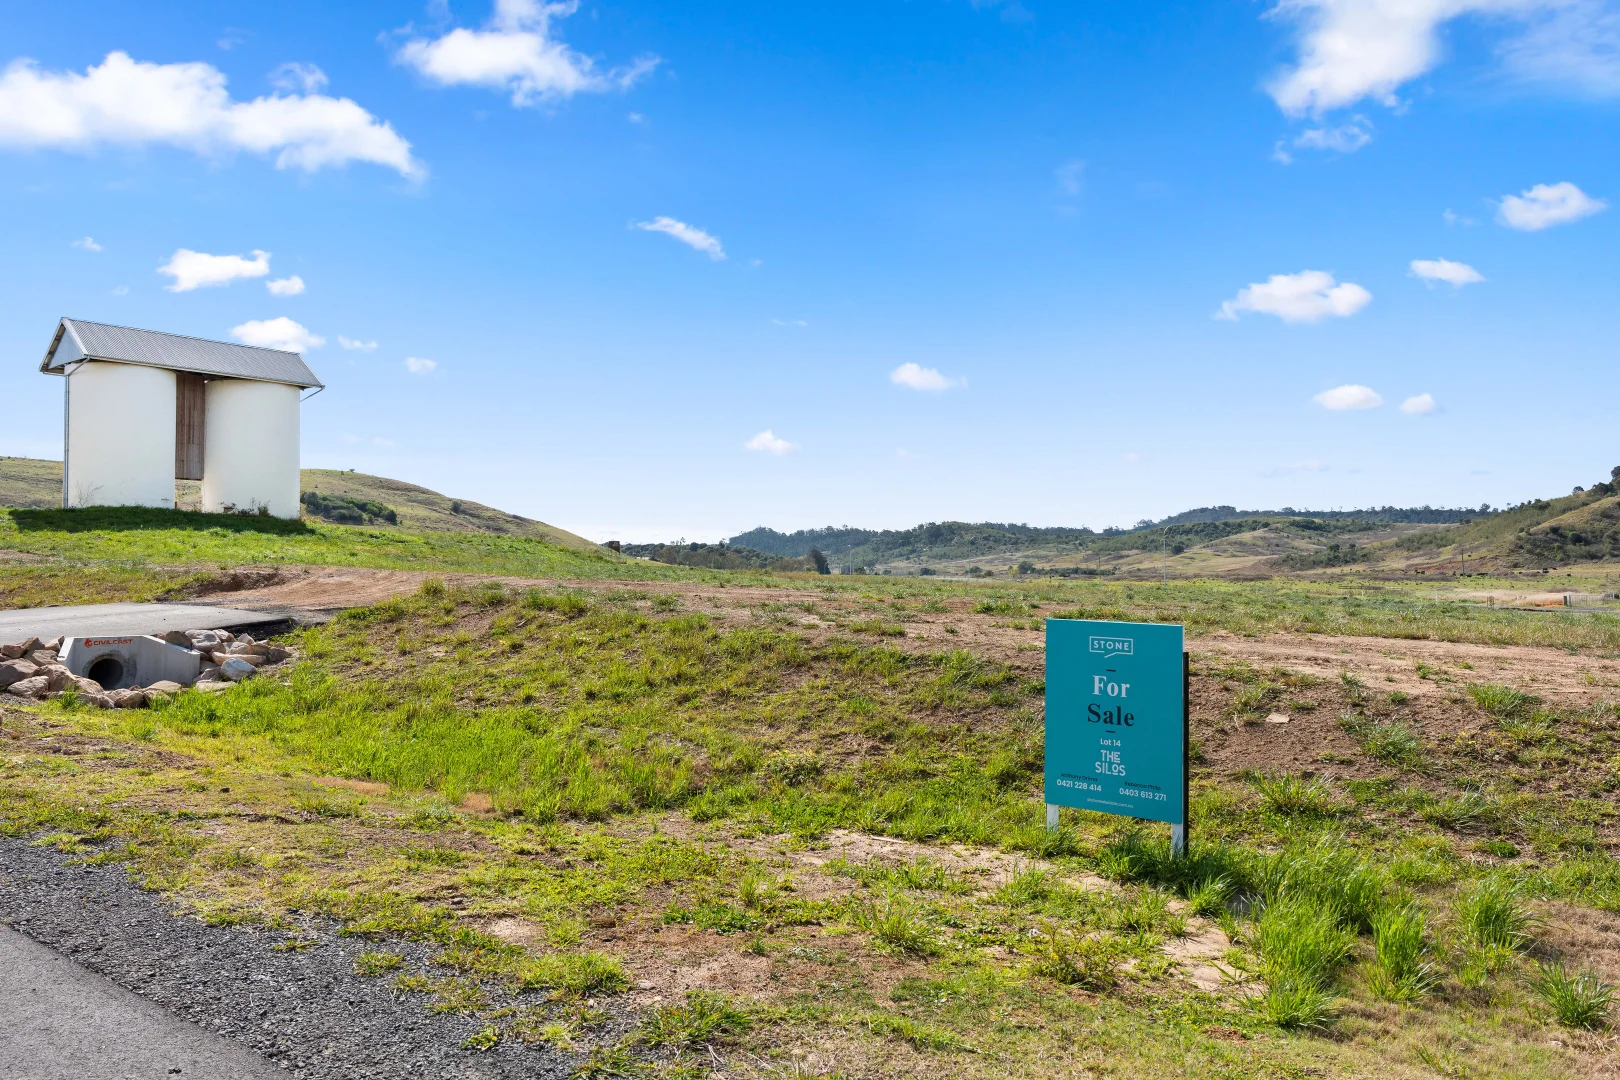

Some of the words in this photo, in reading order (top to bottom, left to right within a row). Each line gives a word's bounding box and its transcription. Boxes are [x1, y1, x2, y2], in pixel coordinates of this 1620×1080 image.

[1093, 640, 1130, 651] STONE
[1092, 674, 1130, 698] For
[1087, 703, 1135, 727] Sale
[1100, 738, 1111, 746] Lot
[1112, 739, 1121, 747] 14
[1100, 749, 1121, 763] THE
[1094, 761, 1126, 777] SILOS
[1056, 778, 1073, 788] 0421
[1074, 781, 1088, 790] 228
[1089, 783, 1102, 792] 414
[1119, 787, 1139, 798] 0403
[1140, 790, 1153, 799] 613
[1154, 792, 1167, 801] 271
